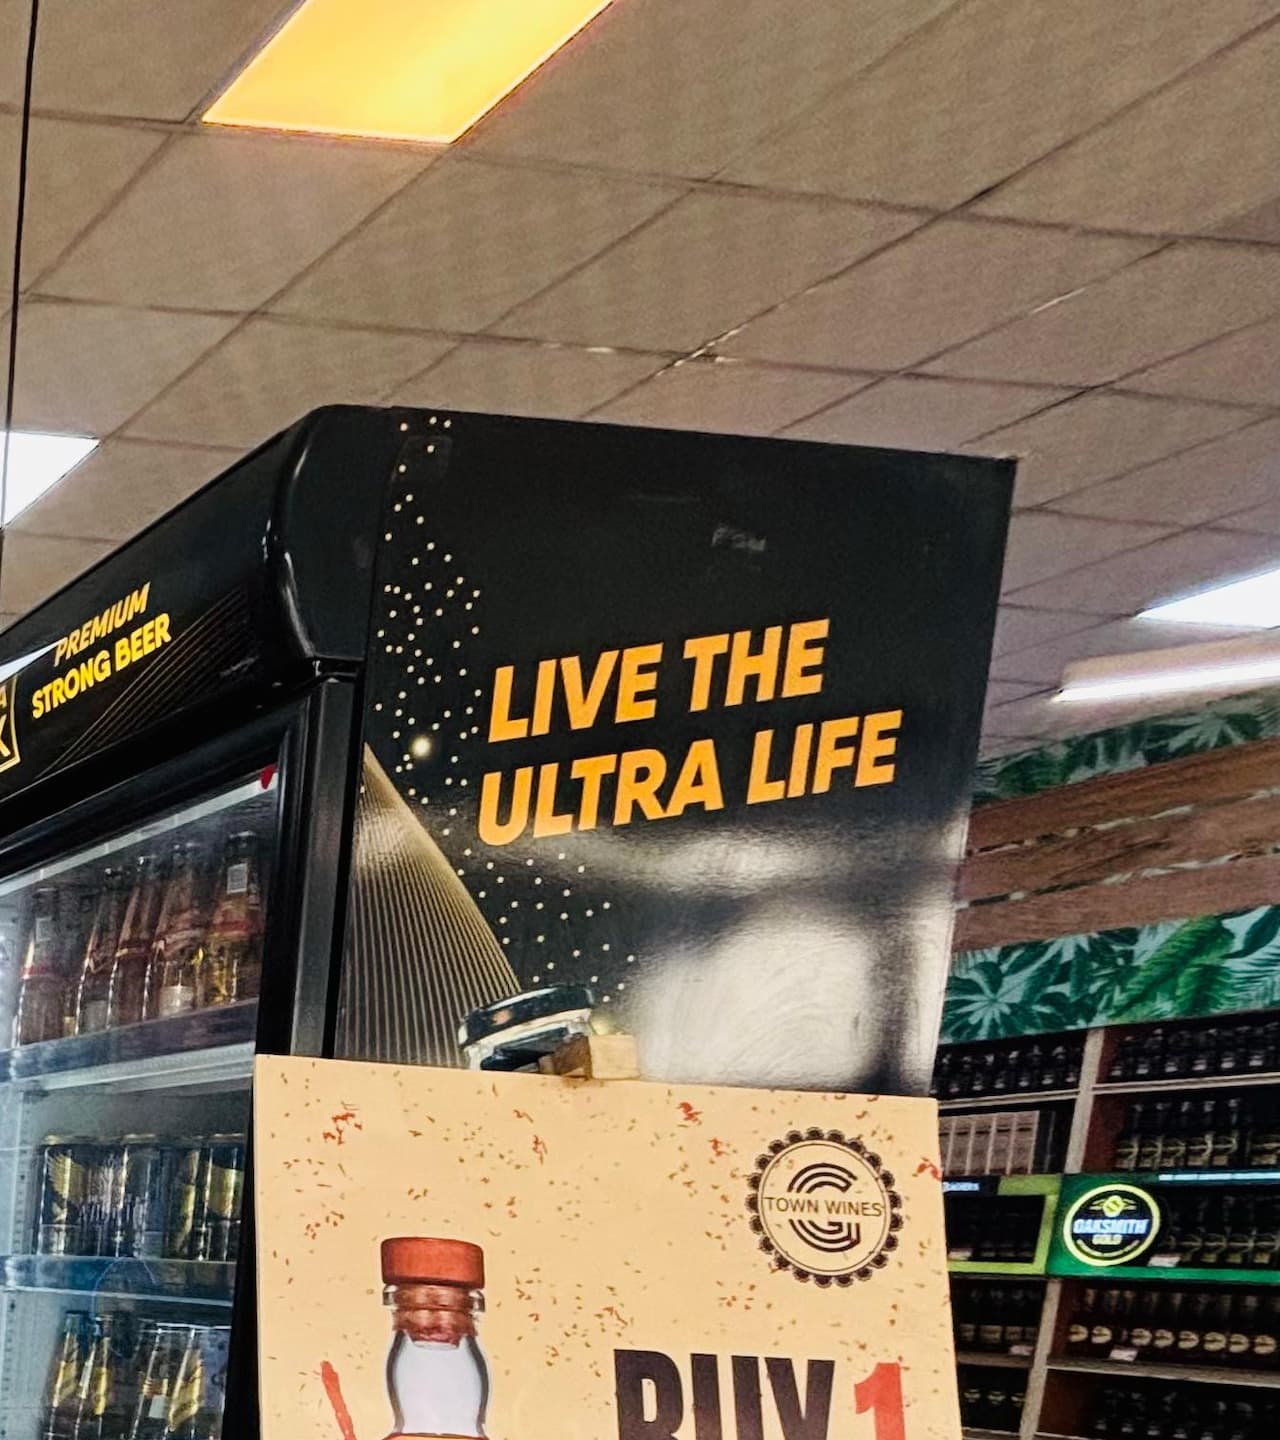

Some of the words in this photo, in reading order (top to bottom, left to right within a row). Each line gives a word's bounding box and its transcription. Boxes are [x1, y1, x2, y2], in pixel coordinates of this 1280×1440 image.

[32, 649, 111, 719] STRONG
[116, 612, 172, 671] BEER
[53, 582, 150, 667] PREMIUM
[488, 643, 663, 742] LIVE
[683, 619, 829, 712] THE
[479, 739, 724, 846] ULTRA
[747, 710, 902, 804] LIFE
[764, 1196, 819, 1213] TOWN
[825, 1199, 883, 1217] WINES
[1072, 1219, 1149, 1235] OAKSMITH
